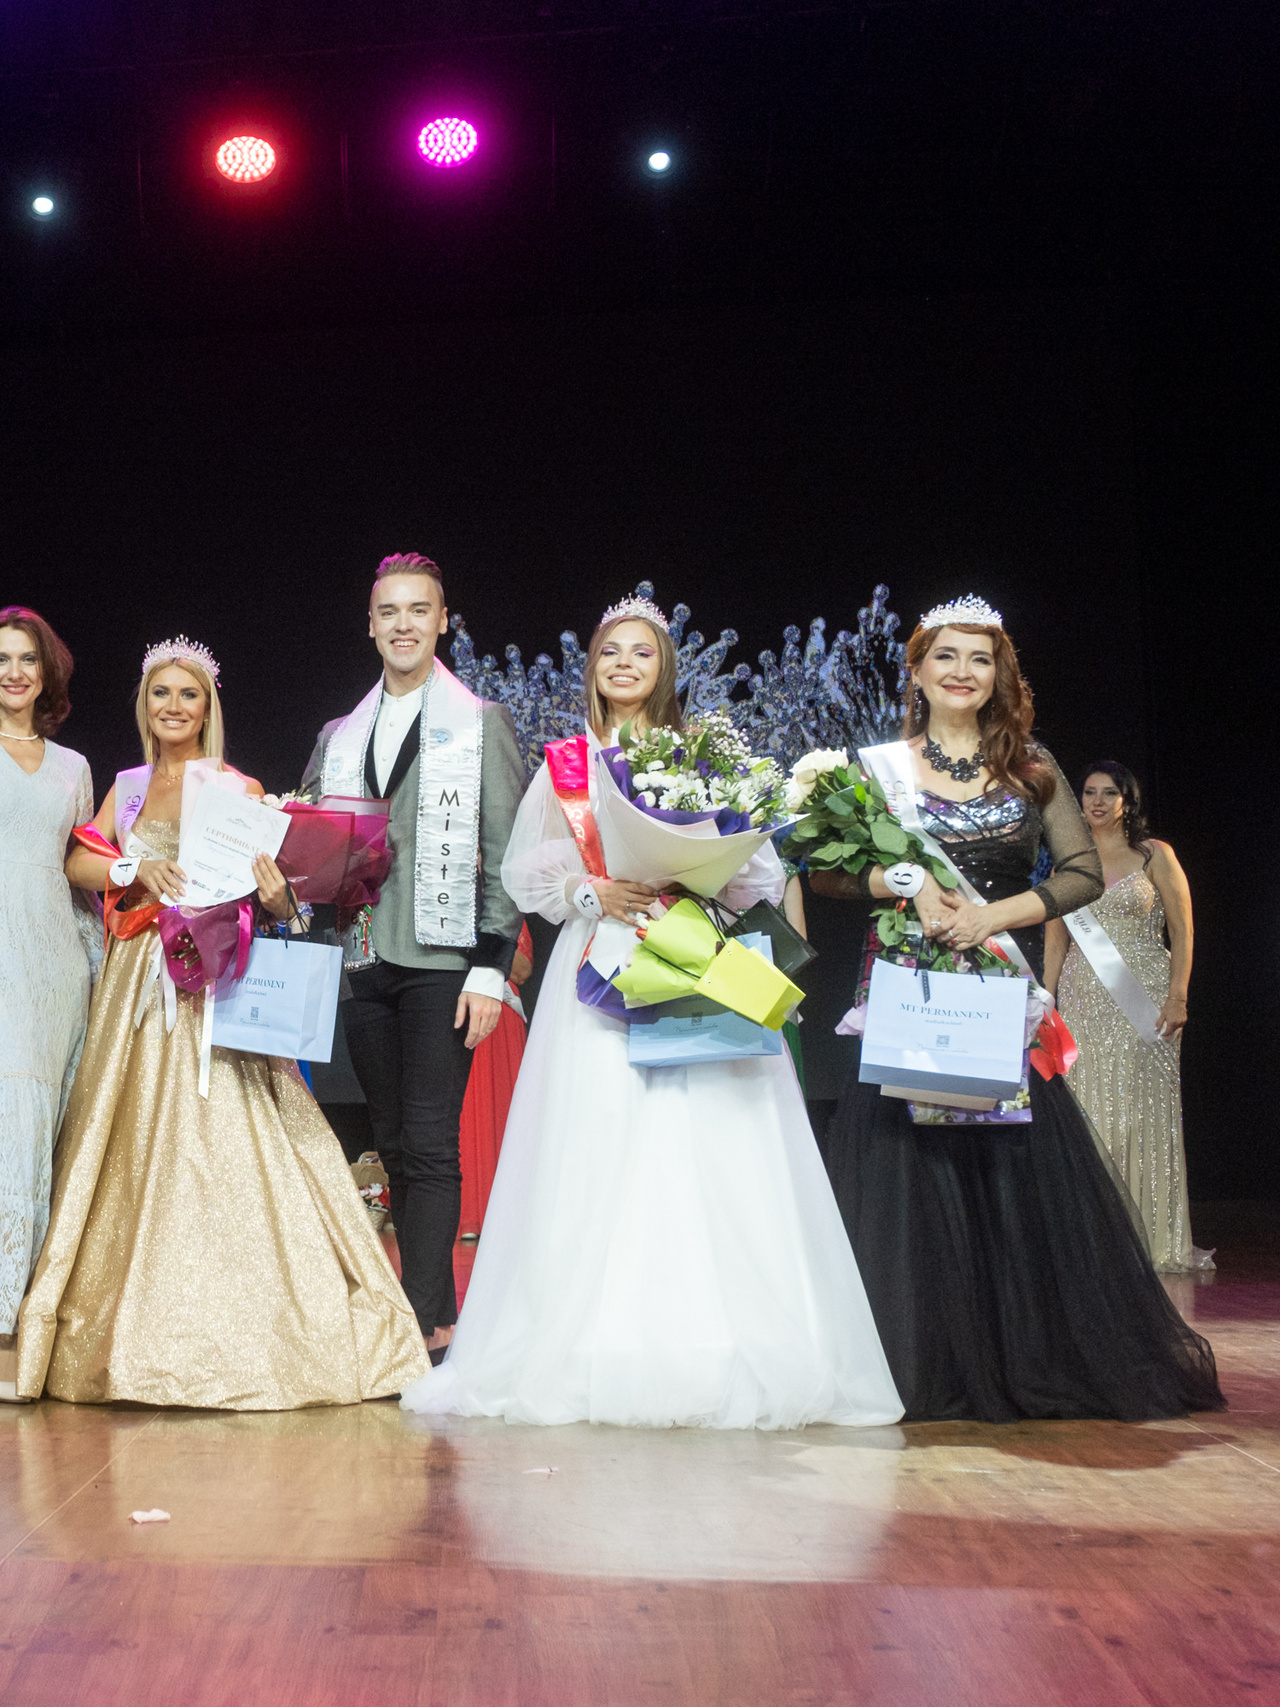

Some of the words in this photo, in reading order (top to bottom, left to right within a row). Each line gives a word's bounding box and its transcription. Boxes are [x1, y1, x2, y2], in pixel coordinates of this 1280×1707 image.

[438, 788, 460, 929] Mister
[118, 862, 132, 872] 4
[893, 872, 913, 886] 6
[579, 893, 594, 908] 5
[245, 976, 287, 990] PERMANENT
[900, 1002, 918, 1013] MT
[920, 1006, 993, 1020] PERMANENT
